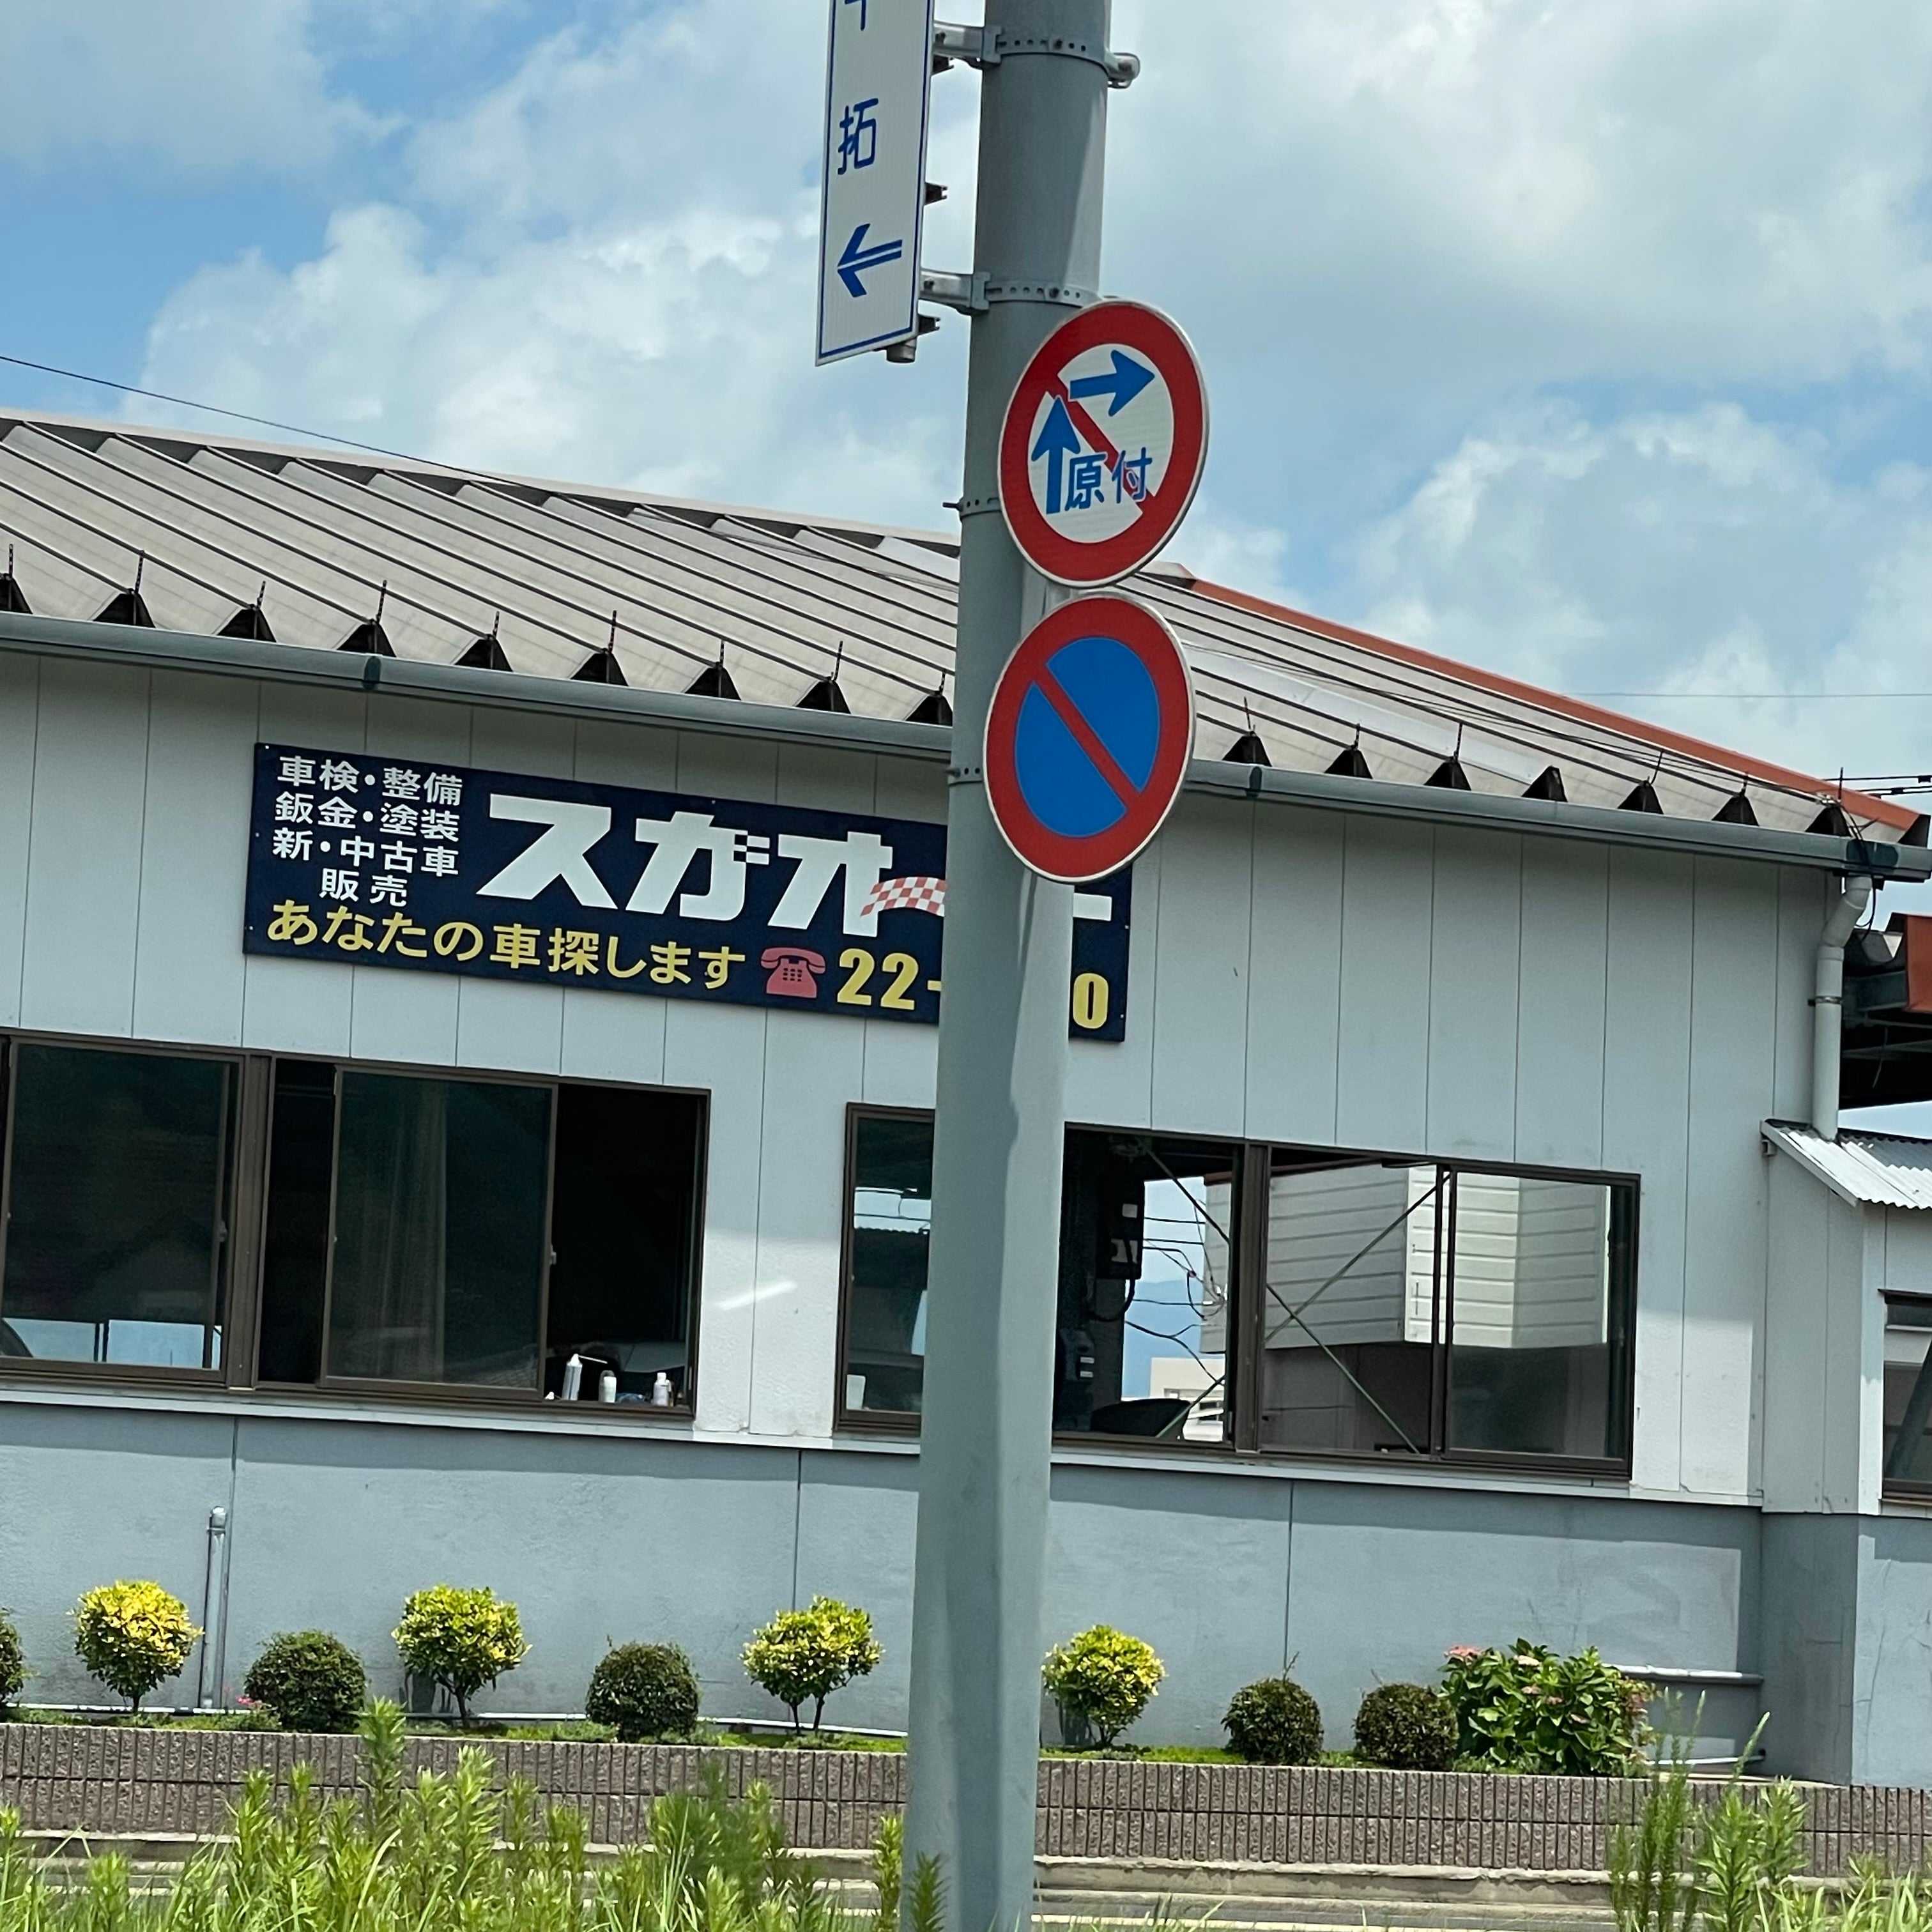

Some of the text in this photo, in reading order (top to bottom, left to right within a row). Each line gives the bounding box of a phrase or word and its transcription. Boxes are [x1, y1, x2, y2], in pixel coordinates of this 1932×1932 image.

[1064, 447, 1153, 512] 原付
[277, 755, 463, 807] 車検・整備
[274, 790, 461, 843] 鈑金・塗装
[272, 826, 459, 878] 新・中古車
[318, 867, 408, 907] 販売
[267, 900, 746, 990] あなたの車探します
[836, 947, 1109, 1029] 22-0
